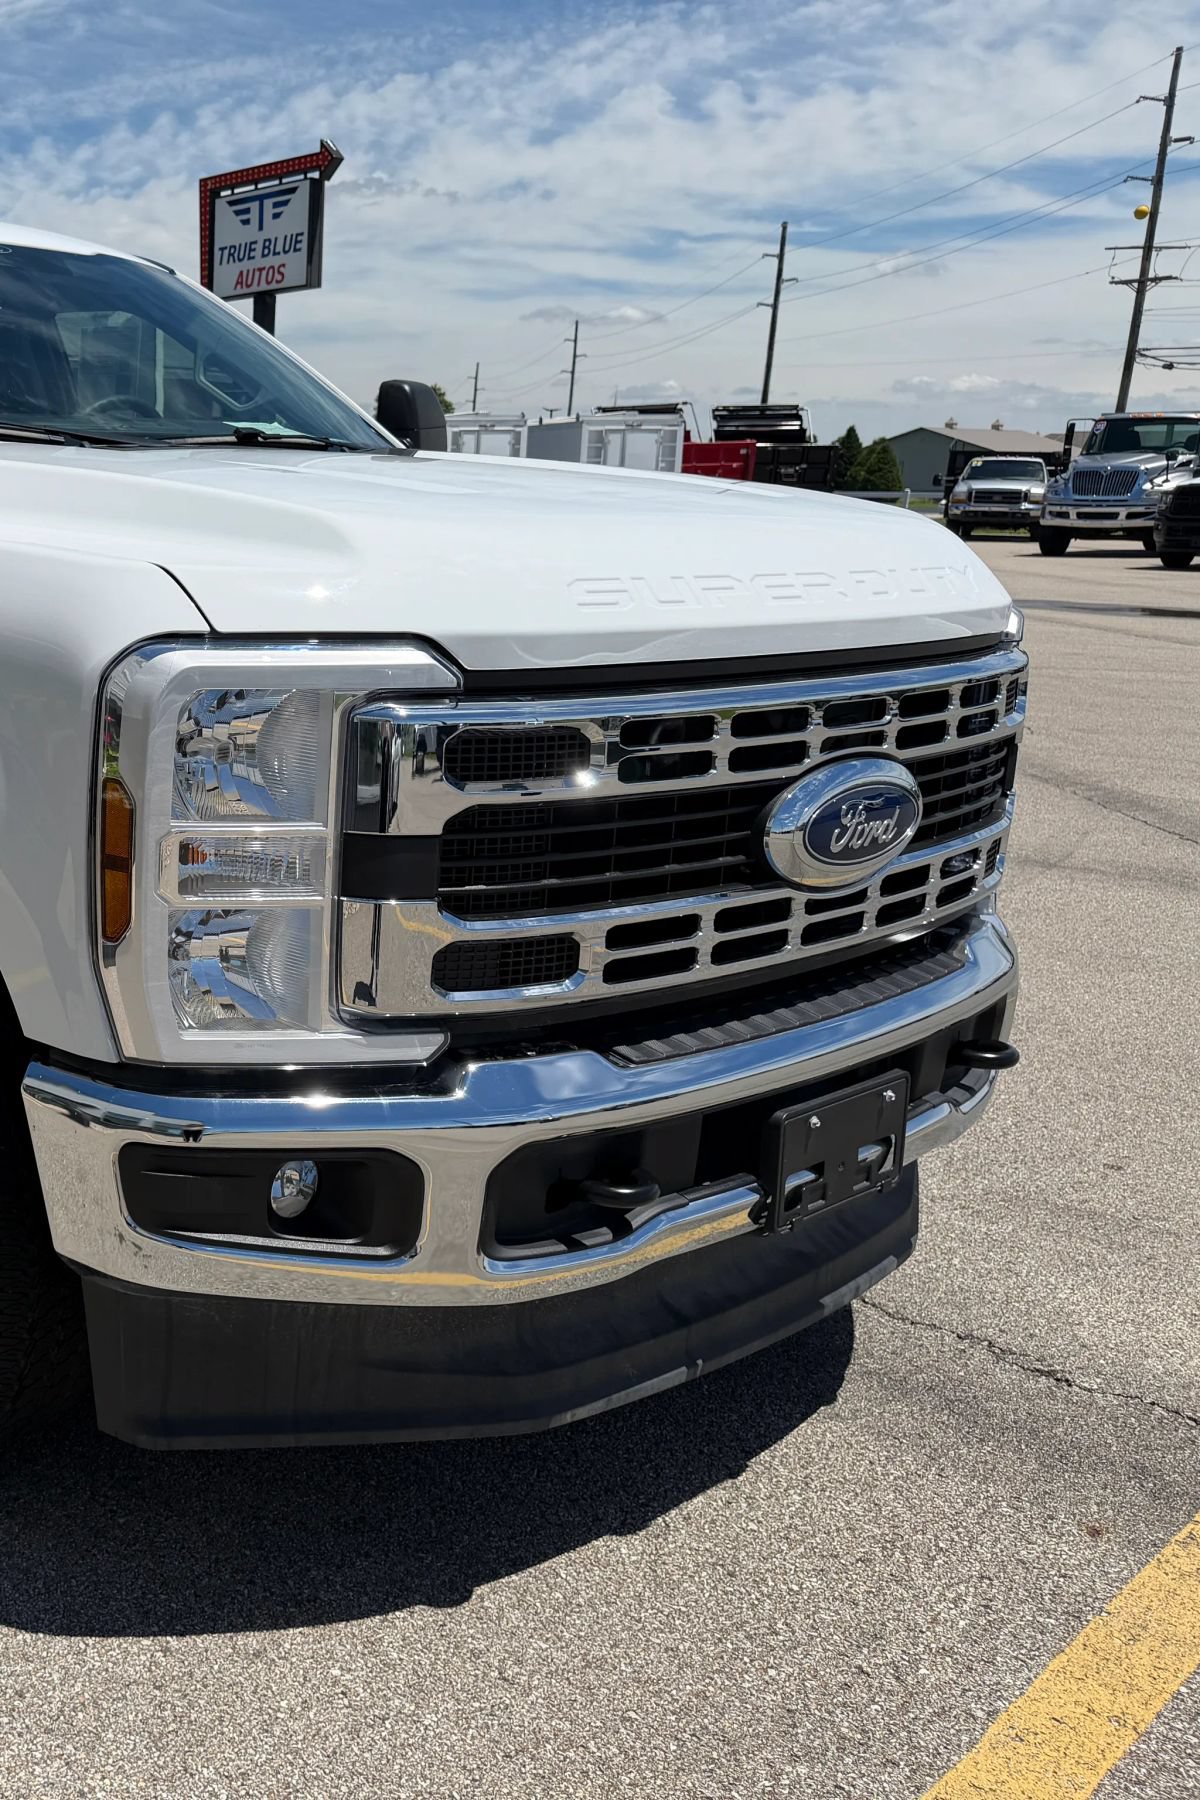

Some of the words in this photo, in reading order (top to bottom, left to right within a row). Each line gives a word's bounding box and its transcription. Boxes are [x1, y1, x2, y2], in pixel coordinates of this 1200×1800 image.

[218, 240, 258, 266] TRUE
[260, 232, 305, 259] BLUE
[233, 263, 287, 291] AUTOS
[566, 573, 849, 613] SUPER
[848, 565, 980, 601] DUTY
[830, 794, 901, 854] Ford
